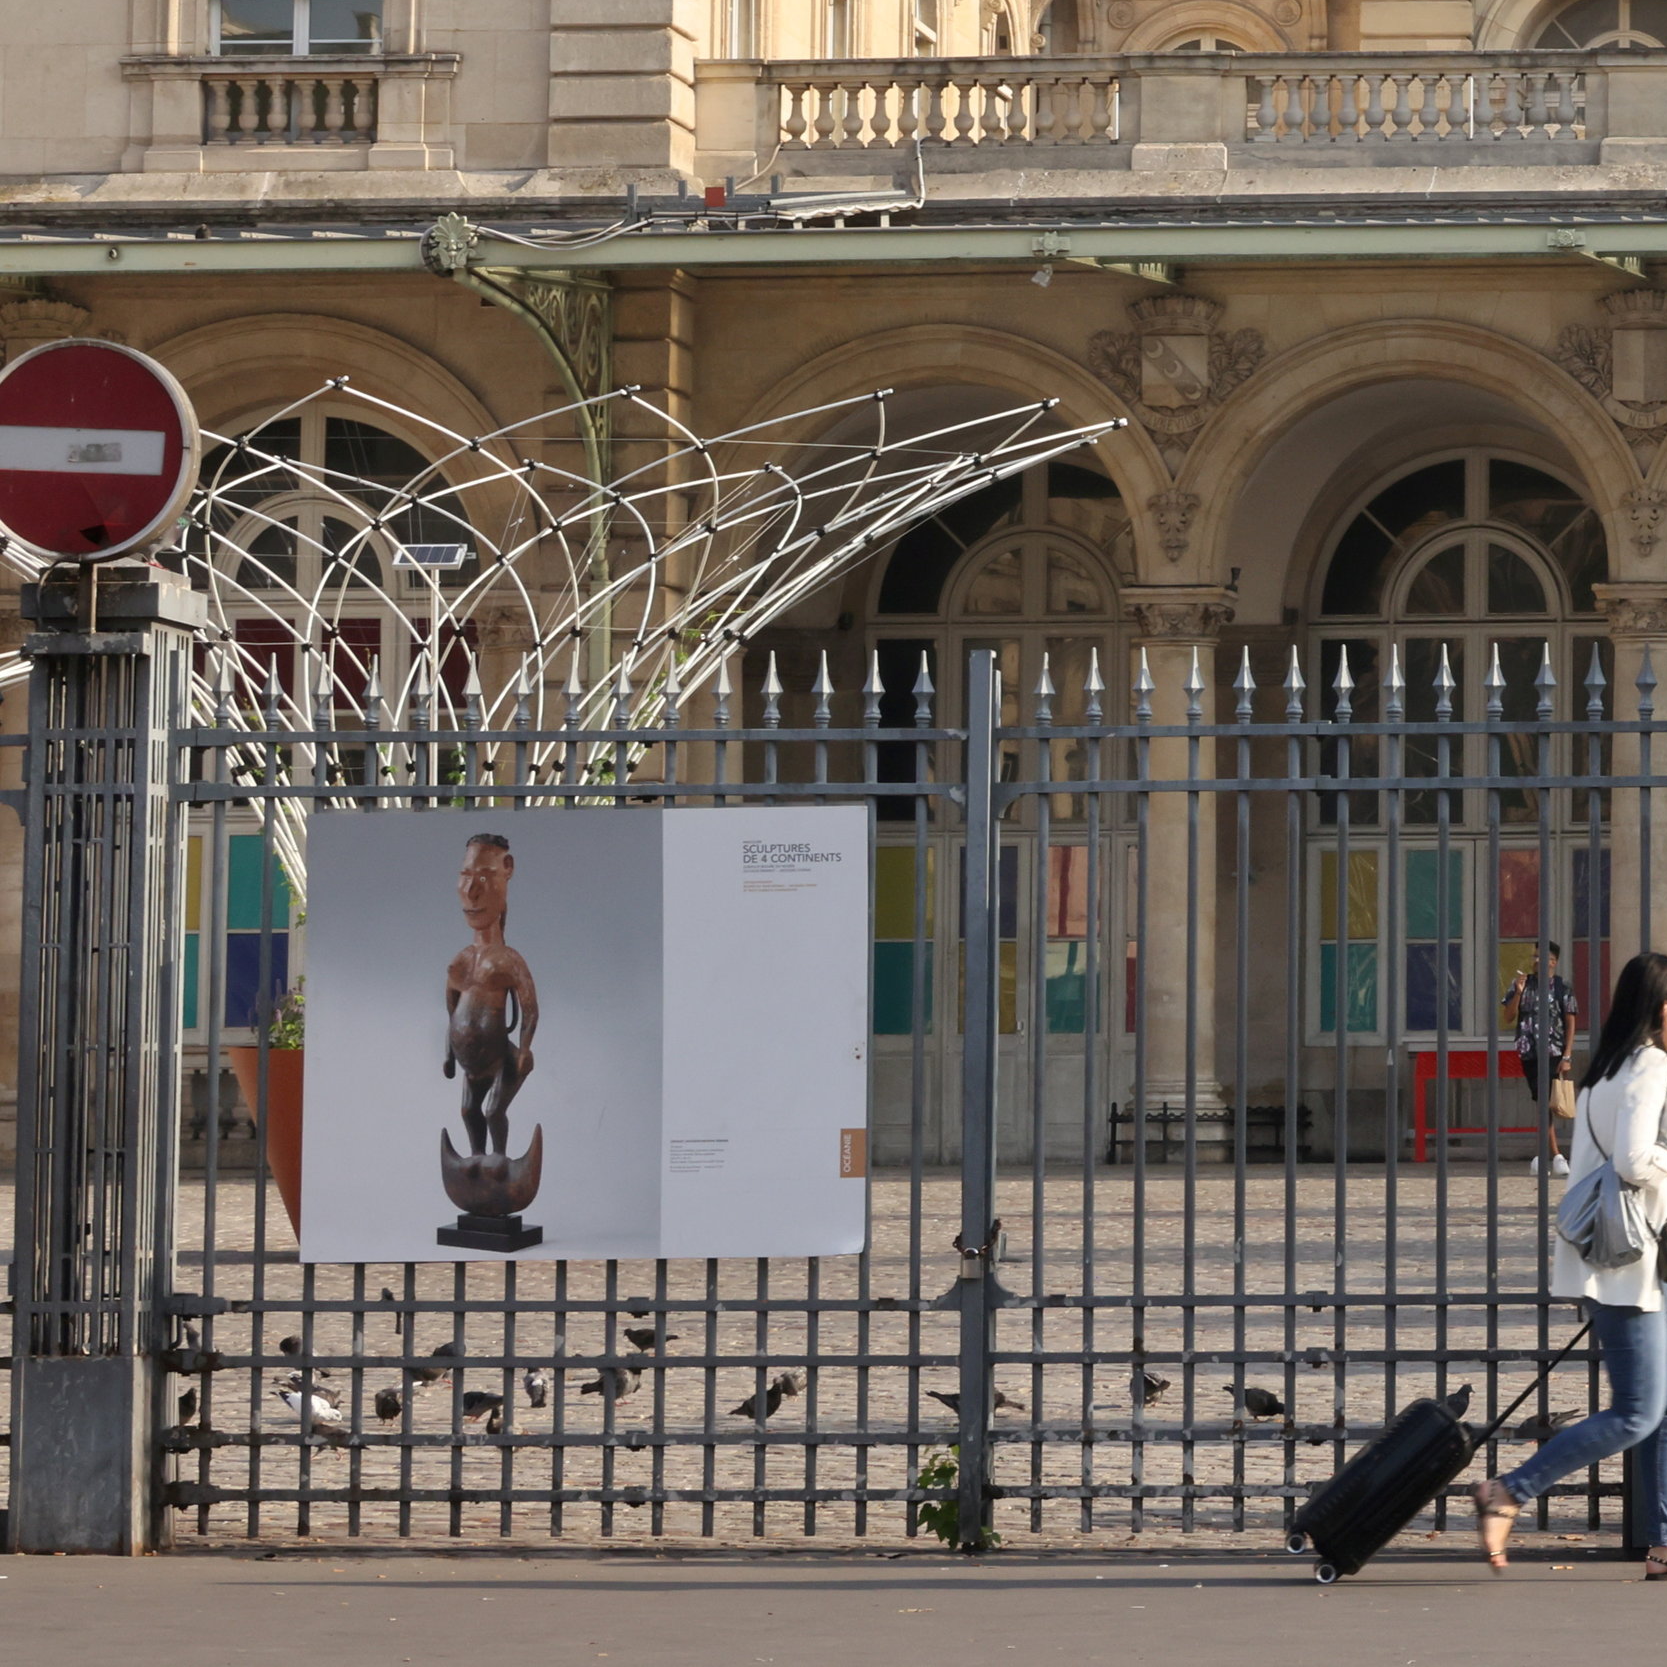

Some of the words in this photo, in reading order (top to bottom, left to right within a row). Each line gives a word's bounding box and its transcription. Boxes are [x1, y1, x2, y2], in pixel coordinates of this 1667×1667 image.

[743, 844, 811, 854] SCULPTURES
[743, 855, 758, 863] DE
[761, 854, 767, 863] 4
[771, 853, 842, 863] CONTINENTS
